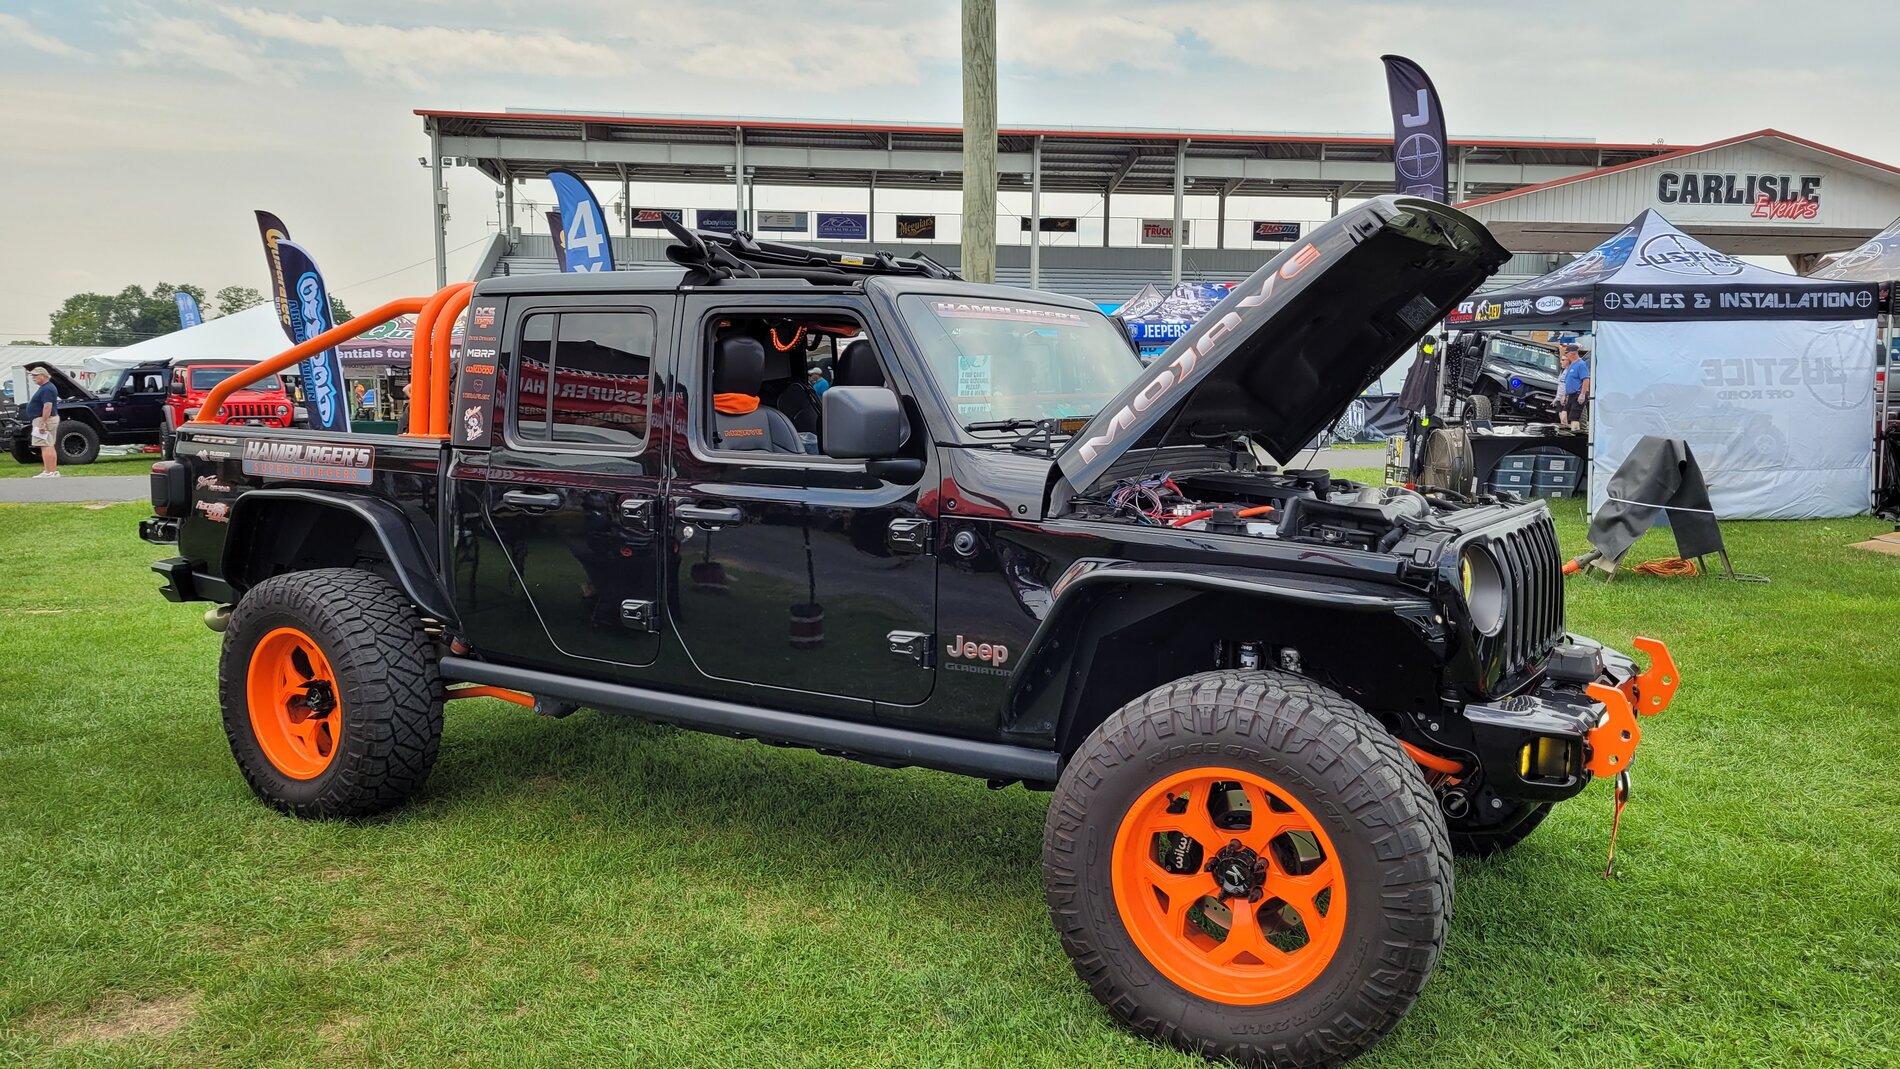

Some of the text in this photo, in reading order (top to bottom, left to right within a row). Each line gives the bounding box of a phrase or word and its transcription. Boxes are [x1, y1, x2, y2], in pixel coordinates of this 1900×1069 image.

[1658, 173, 1821, 204] CARLISLE
[1751, 194, 1819, 220] Events
[1143, 227, 1173, 238] TRUCK
[1256, 223, 1298, 236] AMSOIL
[1622, 291, 1854, 309] SALES & INSTALLATION
[1143, 325, 1187, 338] JEEPERS
[386, 348, 407, 358] for
[466, 349, 496, 358] MBRP
[1078, 242, 1321, 465] MOJAVE
[245, 441, 371, 468] HAMBURGER'S
[252, 462, 358, 480] SUPERCHARGERS
[946, 634, 1009, 667] Jeep
[944, 662, 1014, 677] GLADIATOR
